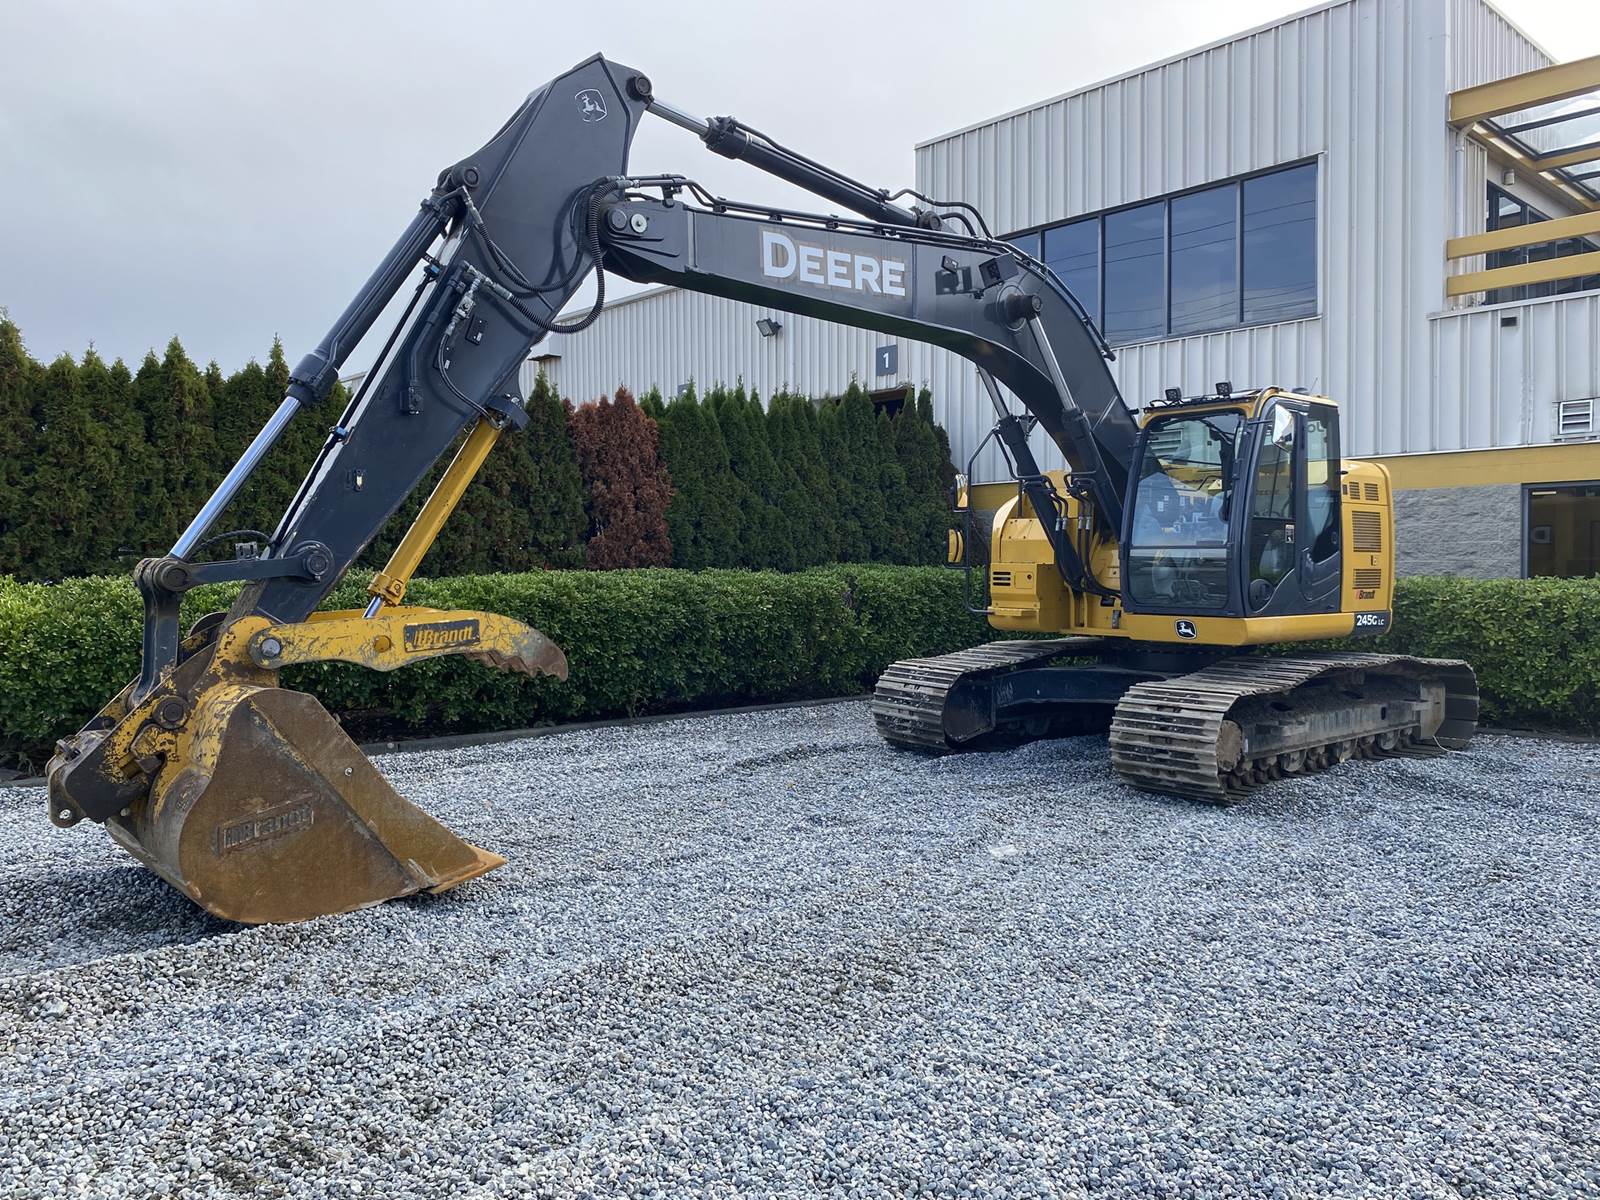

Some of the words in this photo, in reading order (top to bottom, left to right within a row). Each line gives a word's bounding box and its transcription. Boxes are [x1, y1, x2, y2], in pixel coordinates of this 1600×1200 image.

[762, 231, 906, 297] DEERE
[883, 352, 889, 368] 1
[1358, 590, 1375, 599] Brandt
[1356, 614, 1377, 626] 245G
